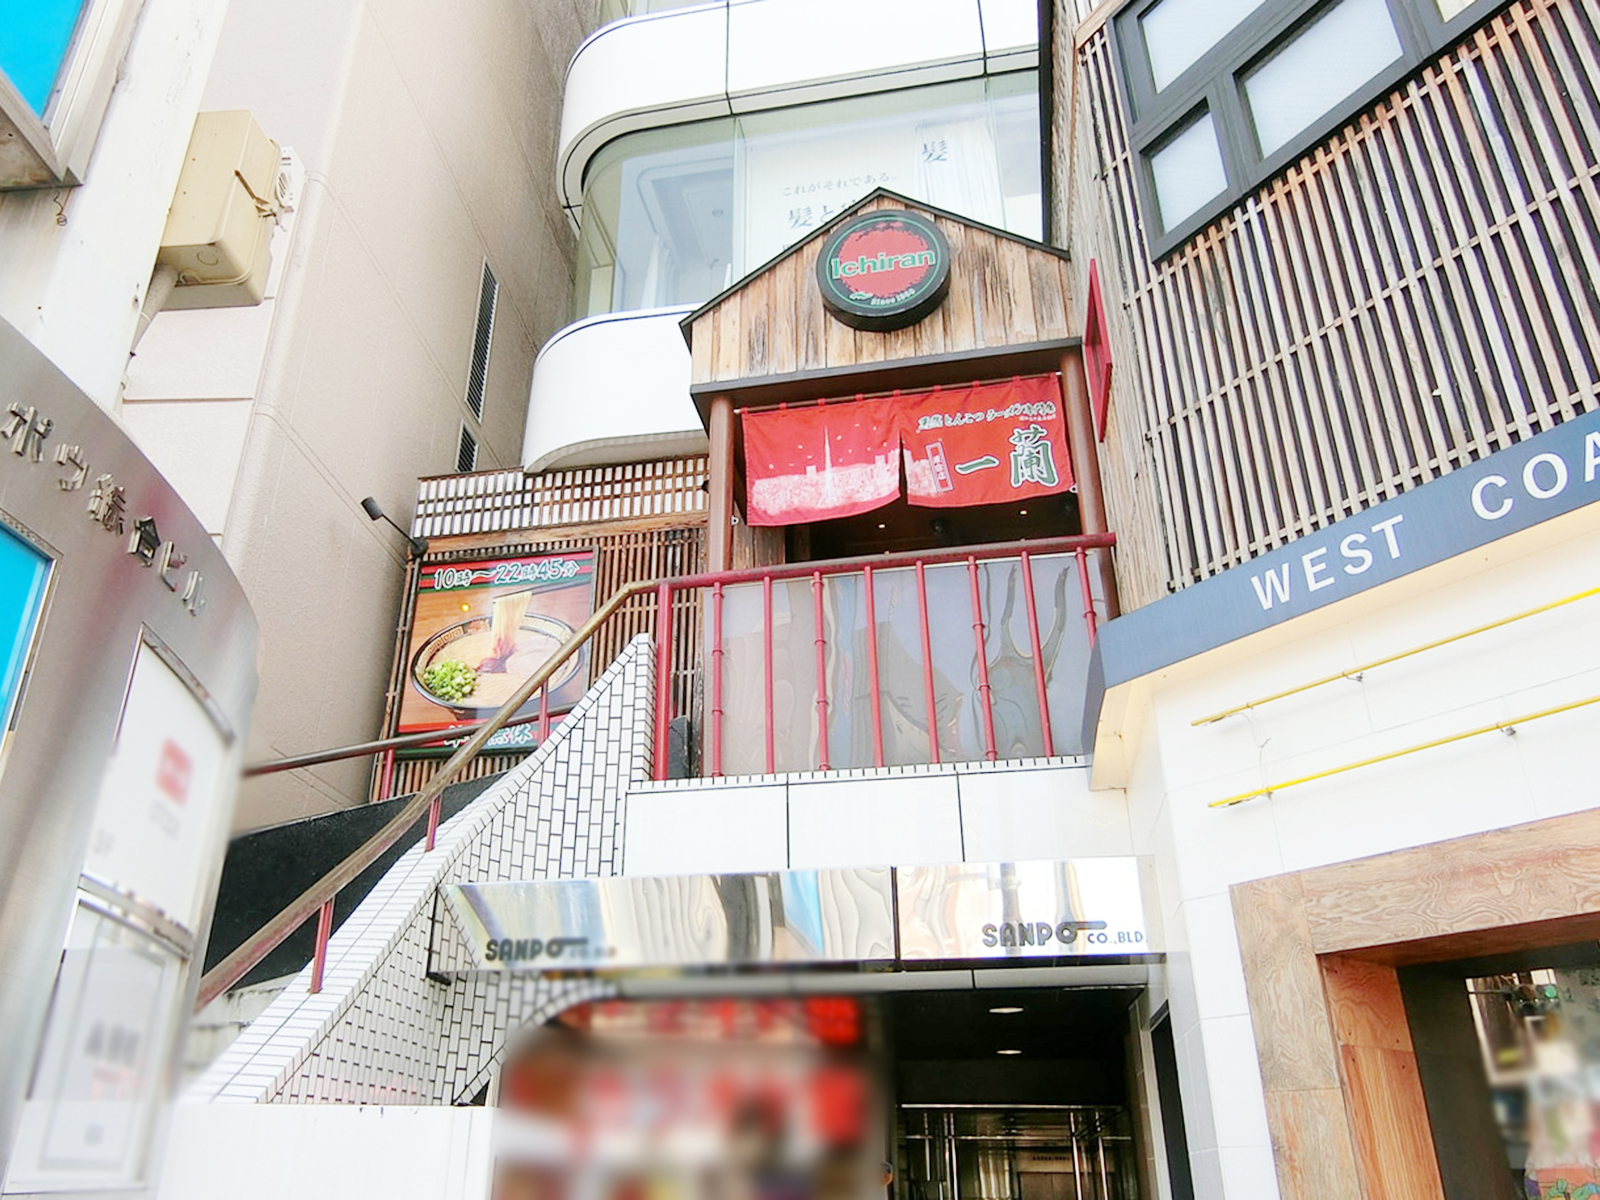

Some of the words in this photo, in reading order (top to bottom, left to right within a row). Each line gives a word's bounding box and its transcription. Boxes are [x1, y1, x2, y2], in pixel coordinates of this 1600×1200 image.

[831, 250, 936, 280] Ichiran
[1250, 514, 1404, 611] WEST
[982, 920, 1108, 947] SANPO
[485, 936, 588, 962] SANPO
